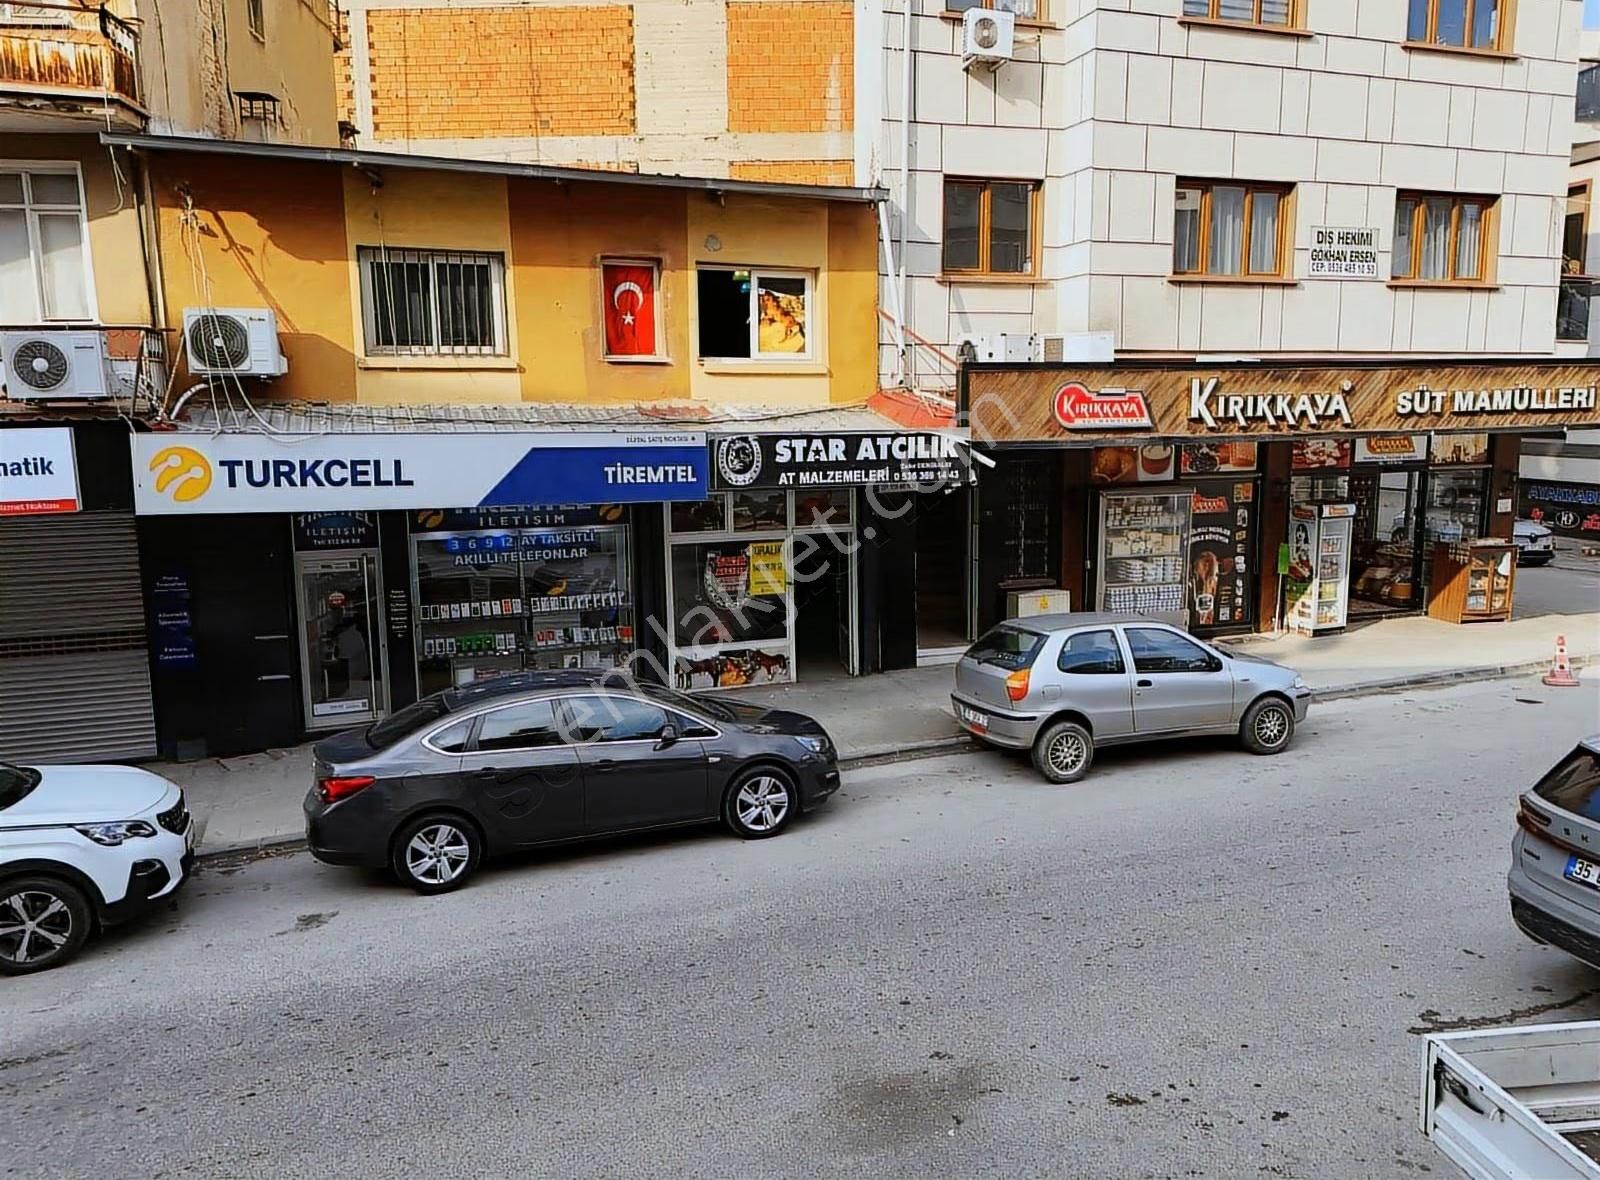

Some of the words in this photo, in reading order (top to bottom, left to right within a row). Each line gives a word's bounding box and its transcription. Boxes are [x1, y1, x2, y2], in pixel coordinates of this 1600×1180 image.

[1063, 394, 1141, 418] KIRIKKAYA
[1189, 377, 1353, 428] KIRIKKAYA
[1395, 384, 1447, 414] SÜT
[1453, 381, 1597, 412] MAMÜLLERİ
[775, 438, 847, 462] STAR
[855, 435, 960, 460] ATCILIK
[218, 459, 414, 488] TURKCELL
[603, 461, 697, 483] TİREMTEL
[778, 472, 796, 484] AT
[799, 466, 889, 483] MALZEMELERİ
[450, 540, 459, 550] 3
[468, 539, 477, 549] 6
[485, 538, 494, 548] 9
[501, 536, 513, 547] 12
[521, 535, 537, 545] AY
[541, 528, 595, 543] TAKSİTLİ
[454, 553, 498, 565] AKILLI
[501, 547, 588, 562] TELEFONLAR
[1574, 861, 1593, 879] 35
